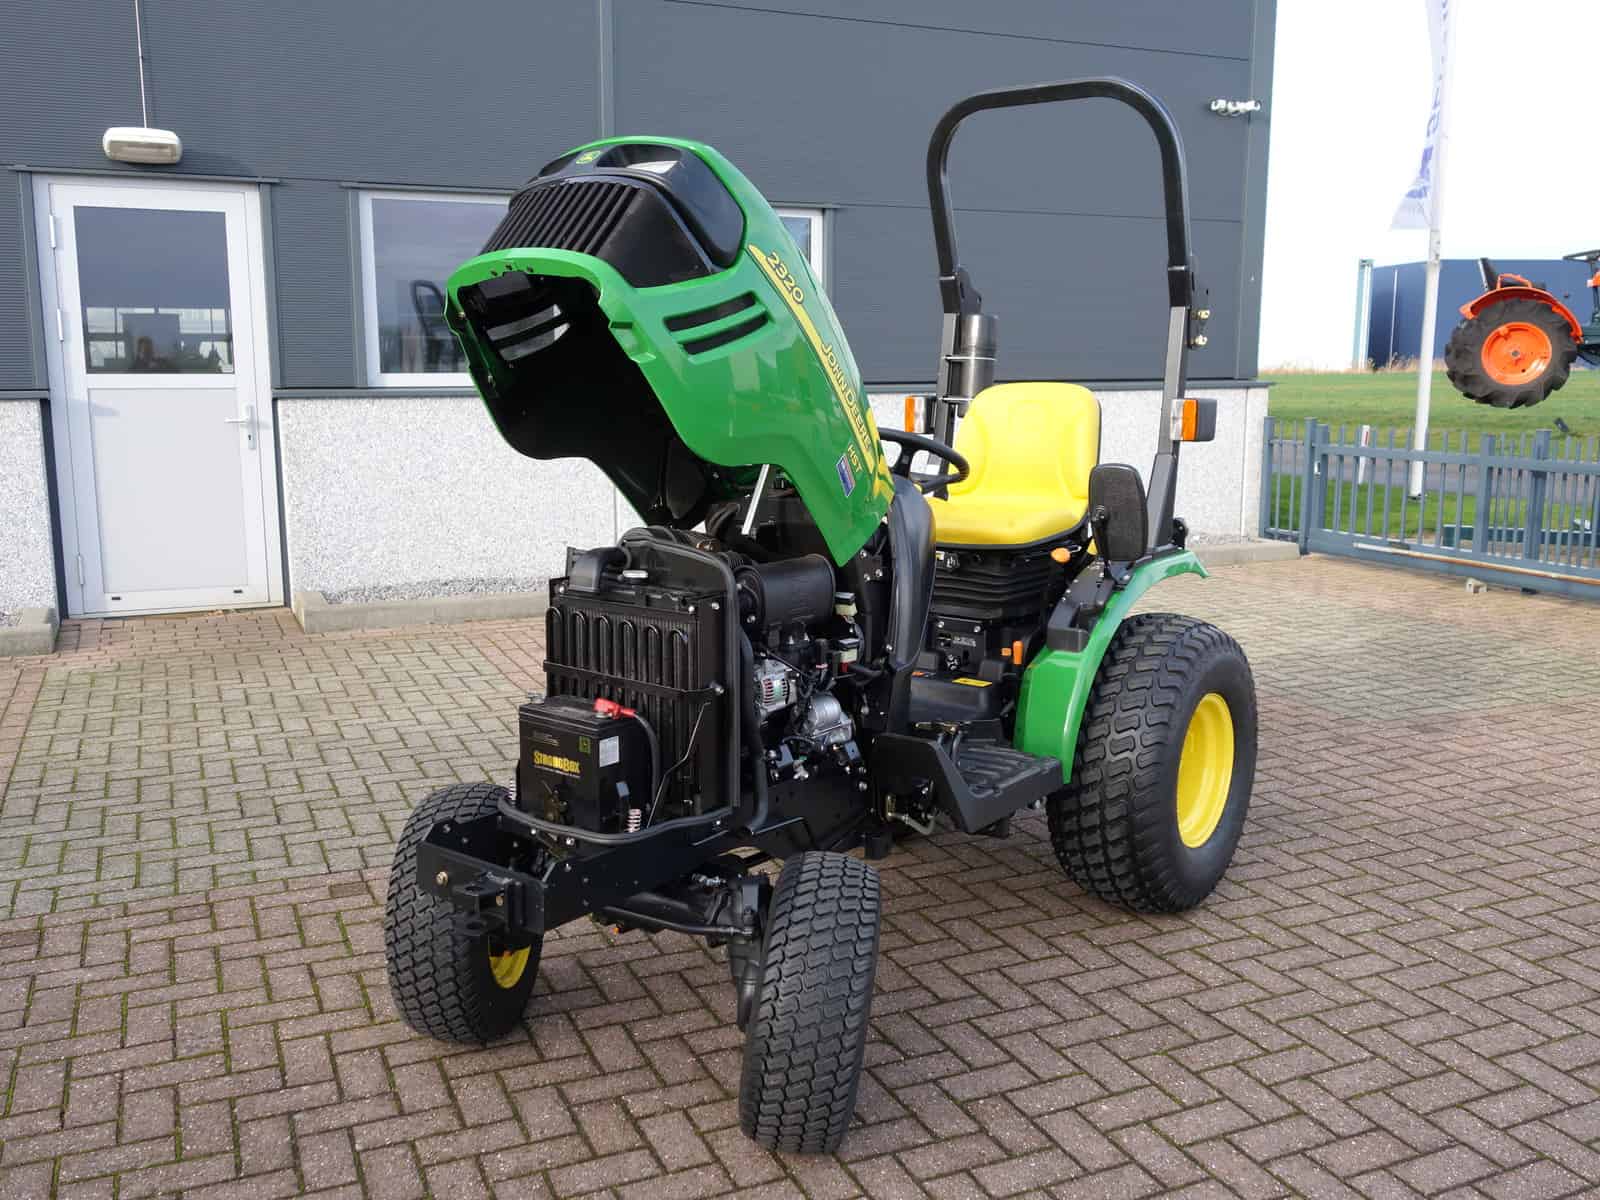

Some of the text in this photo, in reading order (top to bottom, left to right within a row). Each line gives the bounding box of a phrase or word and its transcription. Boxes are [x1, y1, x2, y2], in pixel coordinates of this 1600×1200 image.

[766, 252, 804, 304] 2320
[821, 343, 848, 393] JOHN
[845, 388, 872, 451] DEERE
[847, 443, 863, 473] HST
